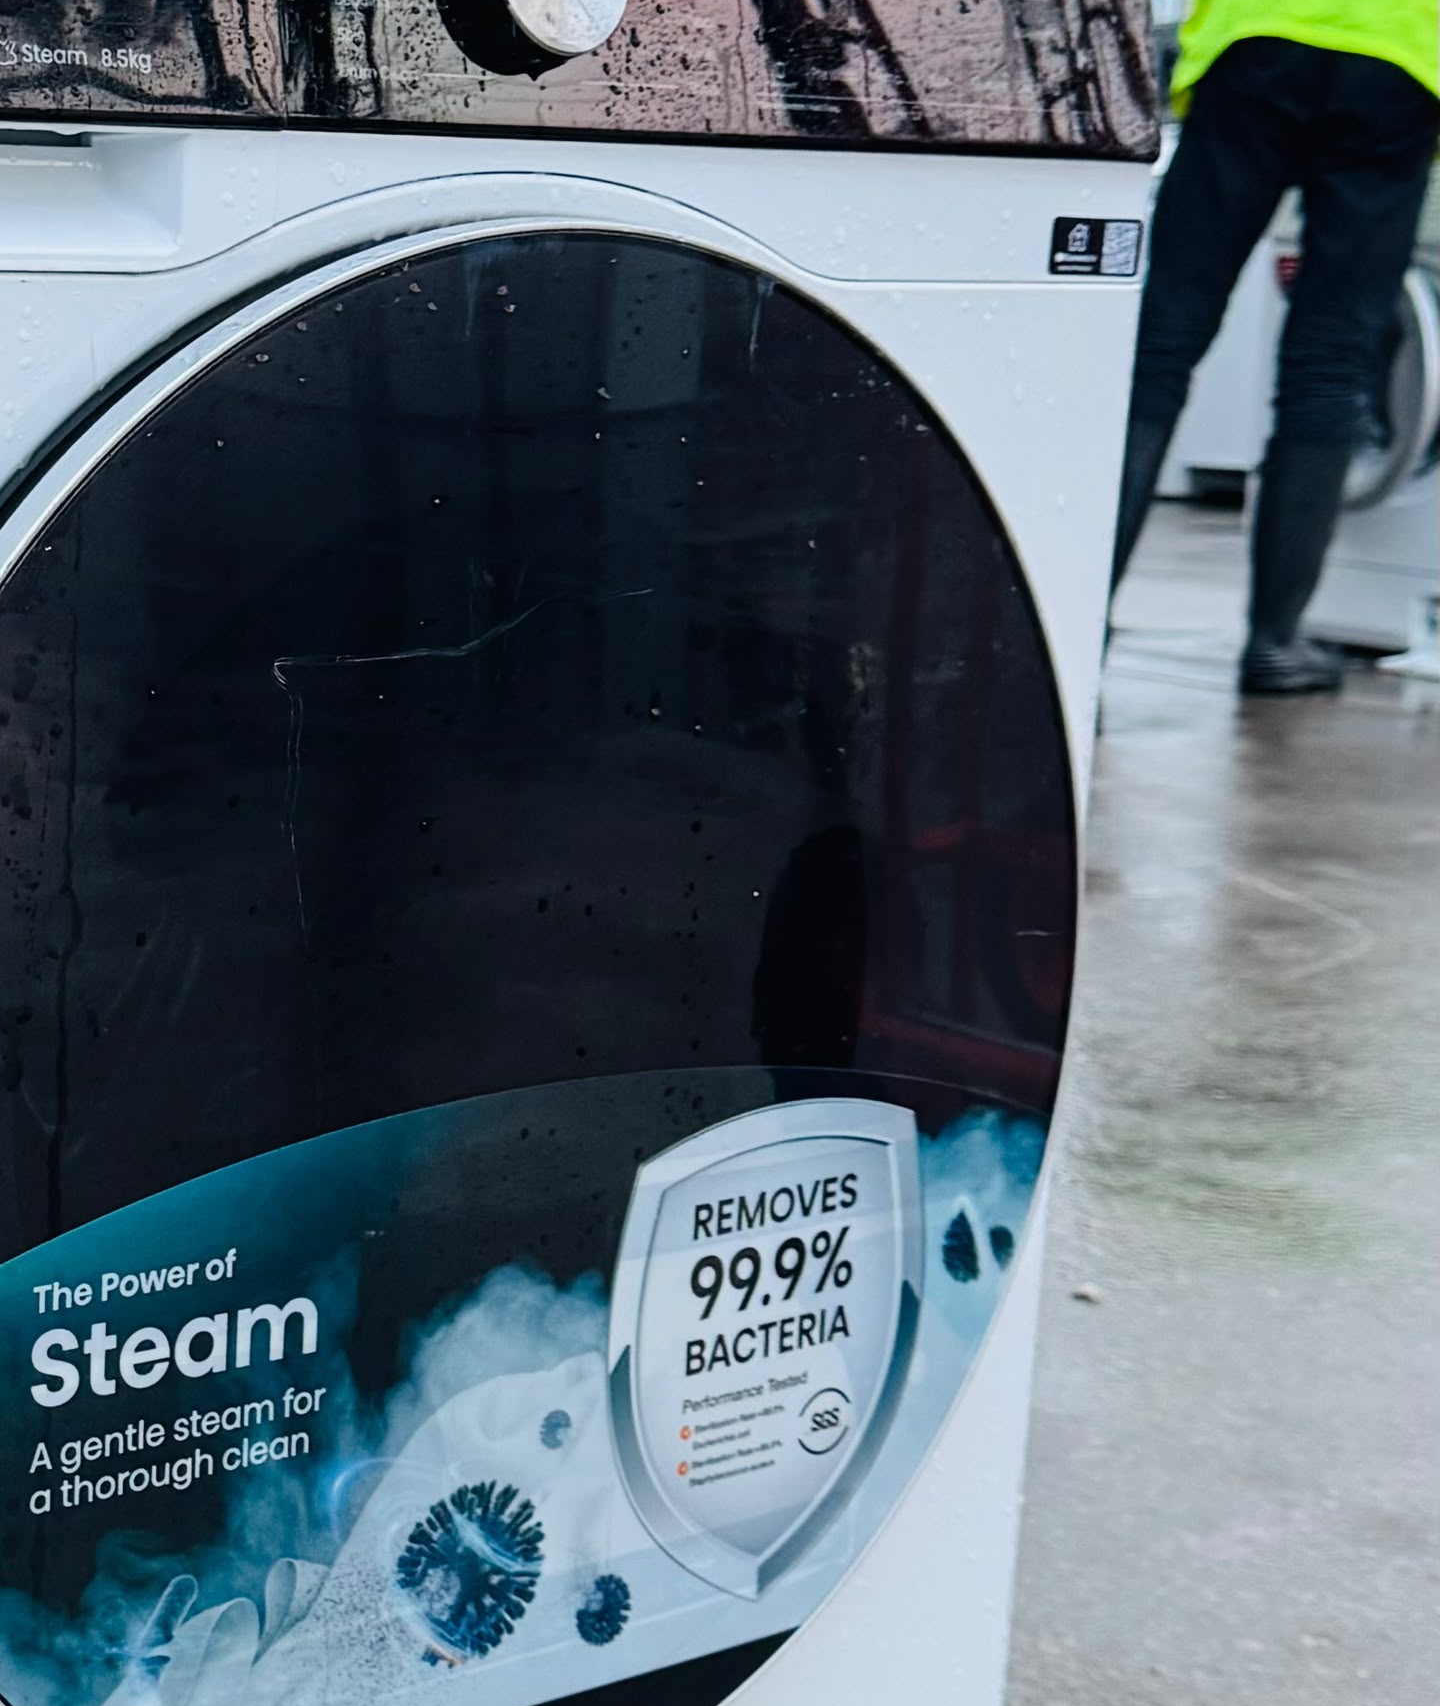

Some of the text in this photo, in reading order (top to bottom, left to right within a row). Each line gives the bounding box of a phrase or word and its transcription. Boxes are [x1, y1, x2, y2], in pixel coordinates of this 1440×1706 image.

[21, 44, 88, 66] Steam
[101, 48, 152, 73] 8.5kg
[693, 1173, 858, 1241] REMOVES
[33, 1248, 237, 1314] The Power of
[690, 1226, 853, 1321] 99.9%
[30, 1297, 318, 1407] Steam
[685, 1305, 850, 1377] BACTERIA
[29, 1387, 327, 1474] A gentle steam for
[682, 1385, 764, 1414] Performance
[29, 1432, 309, 1515] a thorough clean
